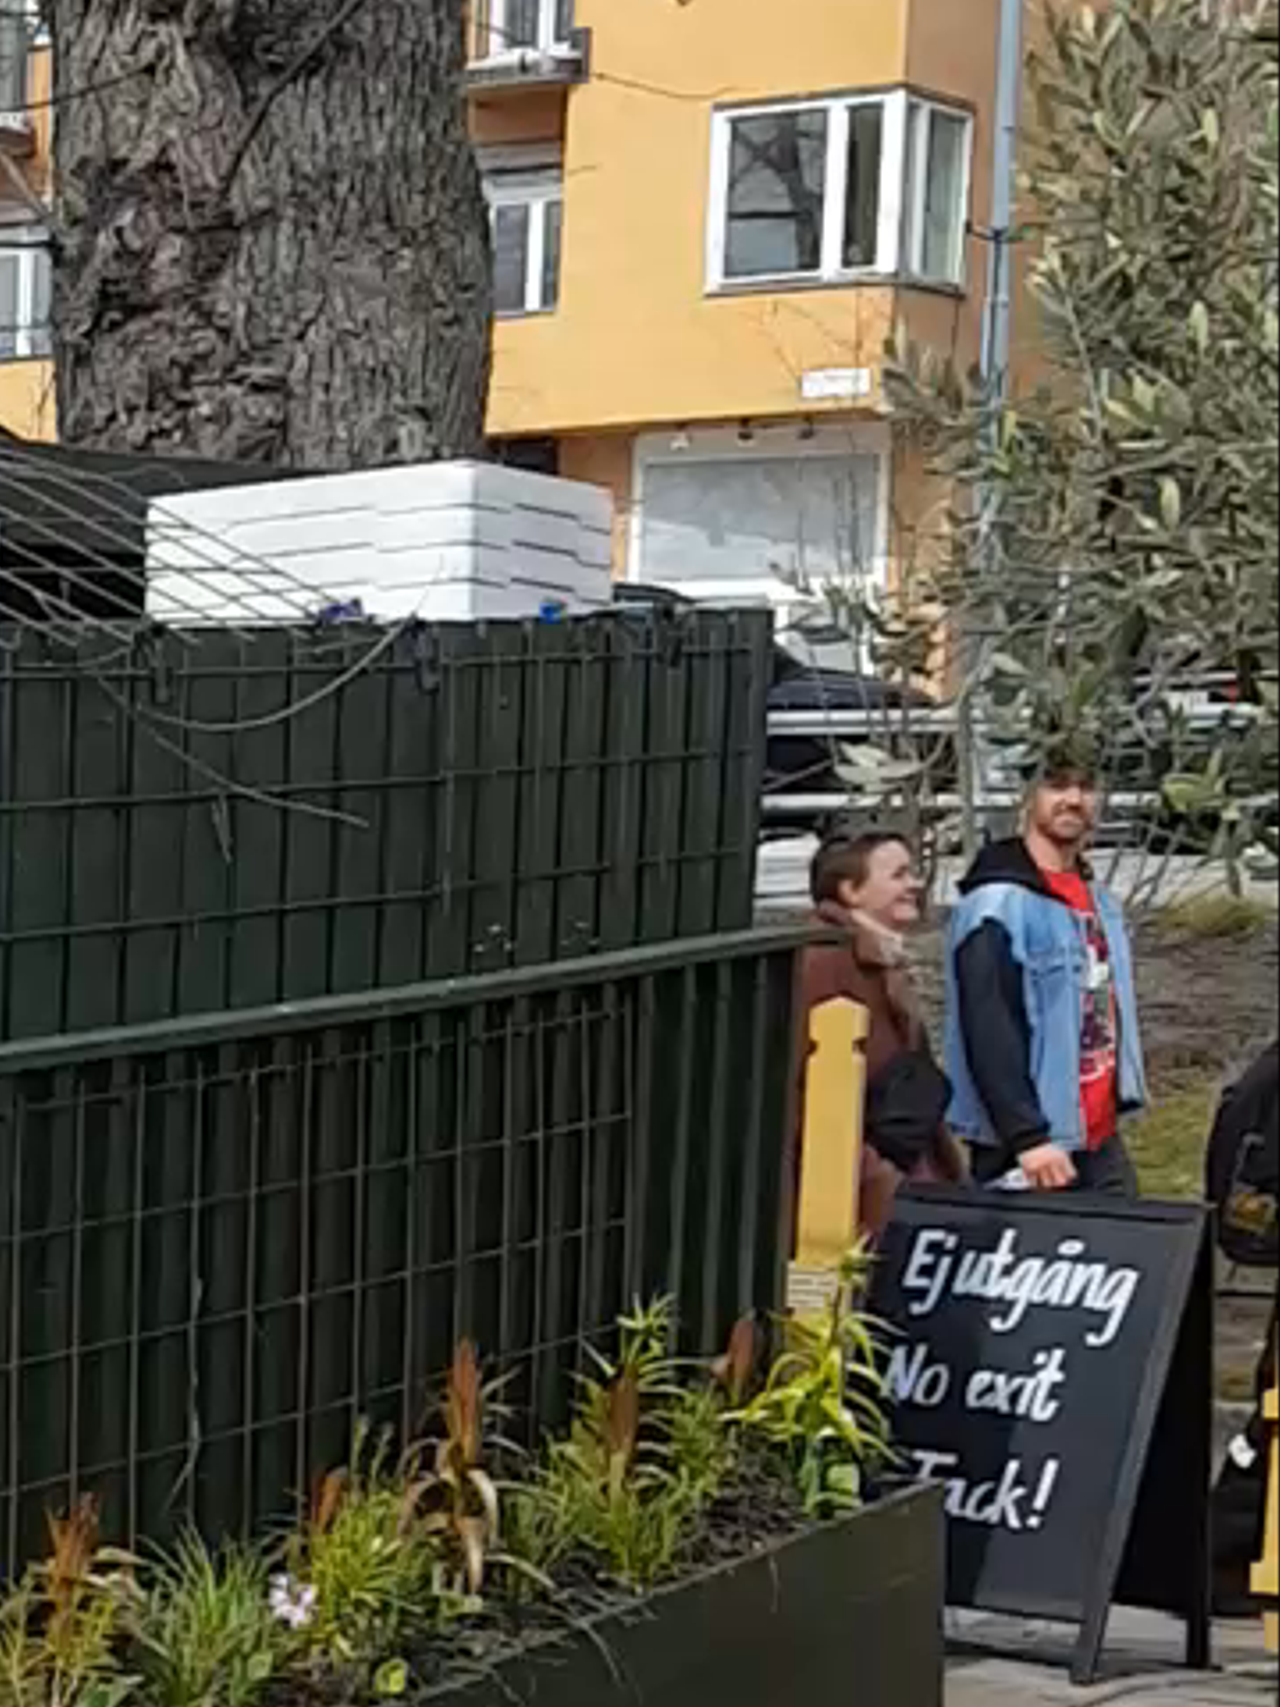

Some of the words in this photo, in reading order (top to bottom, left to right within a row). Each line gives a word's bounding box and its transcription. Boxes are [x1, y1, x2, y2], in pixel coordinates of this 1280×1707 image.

[901, 1228, 958, 1315] Ej
[951, 1227, 1140, 1347] utgång
[880, 1343, 950, 1406] No
[965, 1348, 1066, 1422] exit
[911, 1449, 1060, 1529] Tack!
